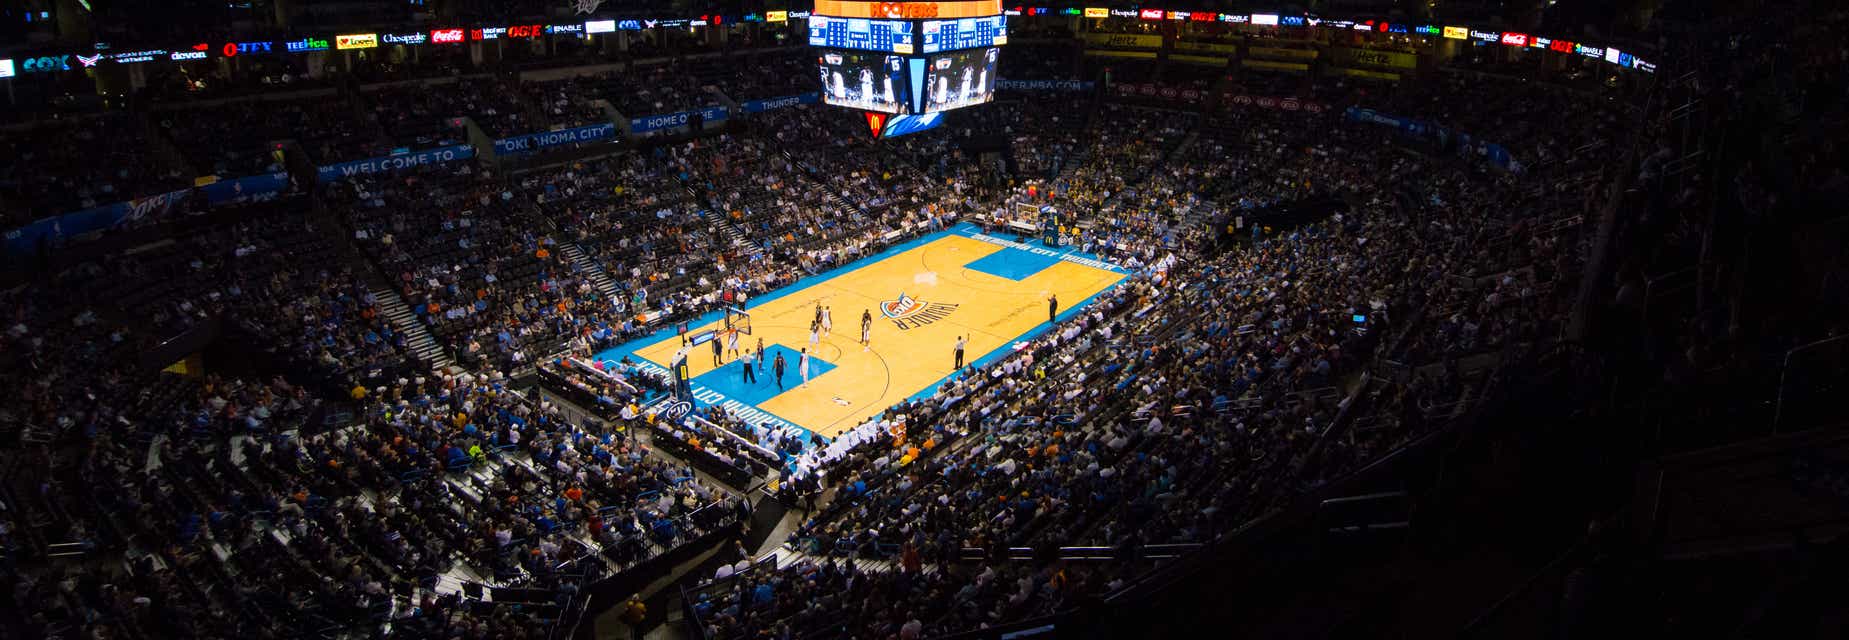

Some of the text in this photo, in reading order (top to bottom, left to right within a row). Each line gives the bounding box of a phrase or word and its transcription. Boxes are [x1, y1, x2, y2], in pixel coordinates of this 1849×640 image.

[870, 3, 938, 18] HOOTERS
[553, 24, 582, 32] ENABLE
[23, 54, 72, 71] COX
[171, 51, 207, 60] devon
[648, 115, 678, 129] HOME
[580, 127, 606, 140] CITY
[342, 149, 454, 177] WELCOME TO
